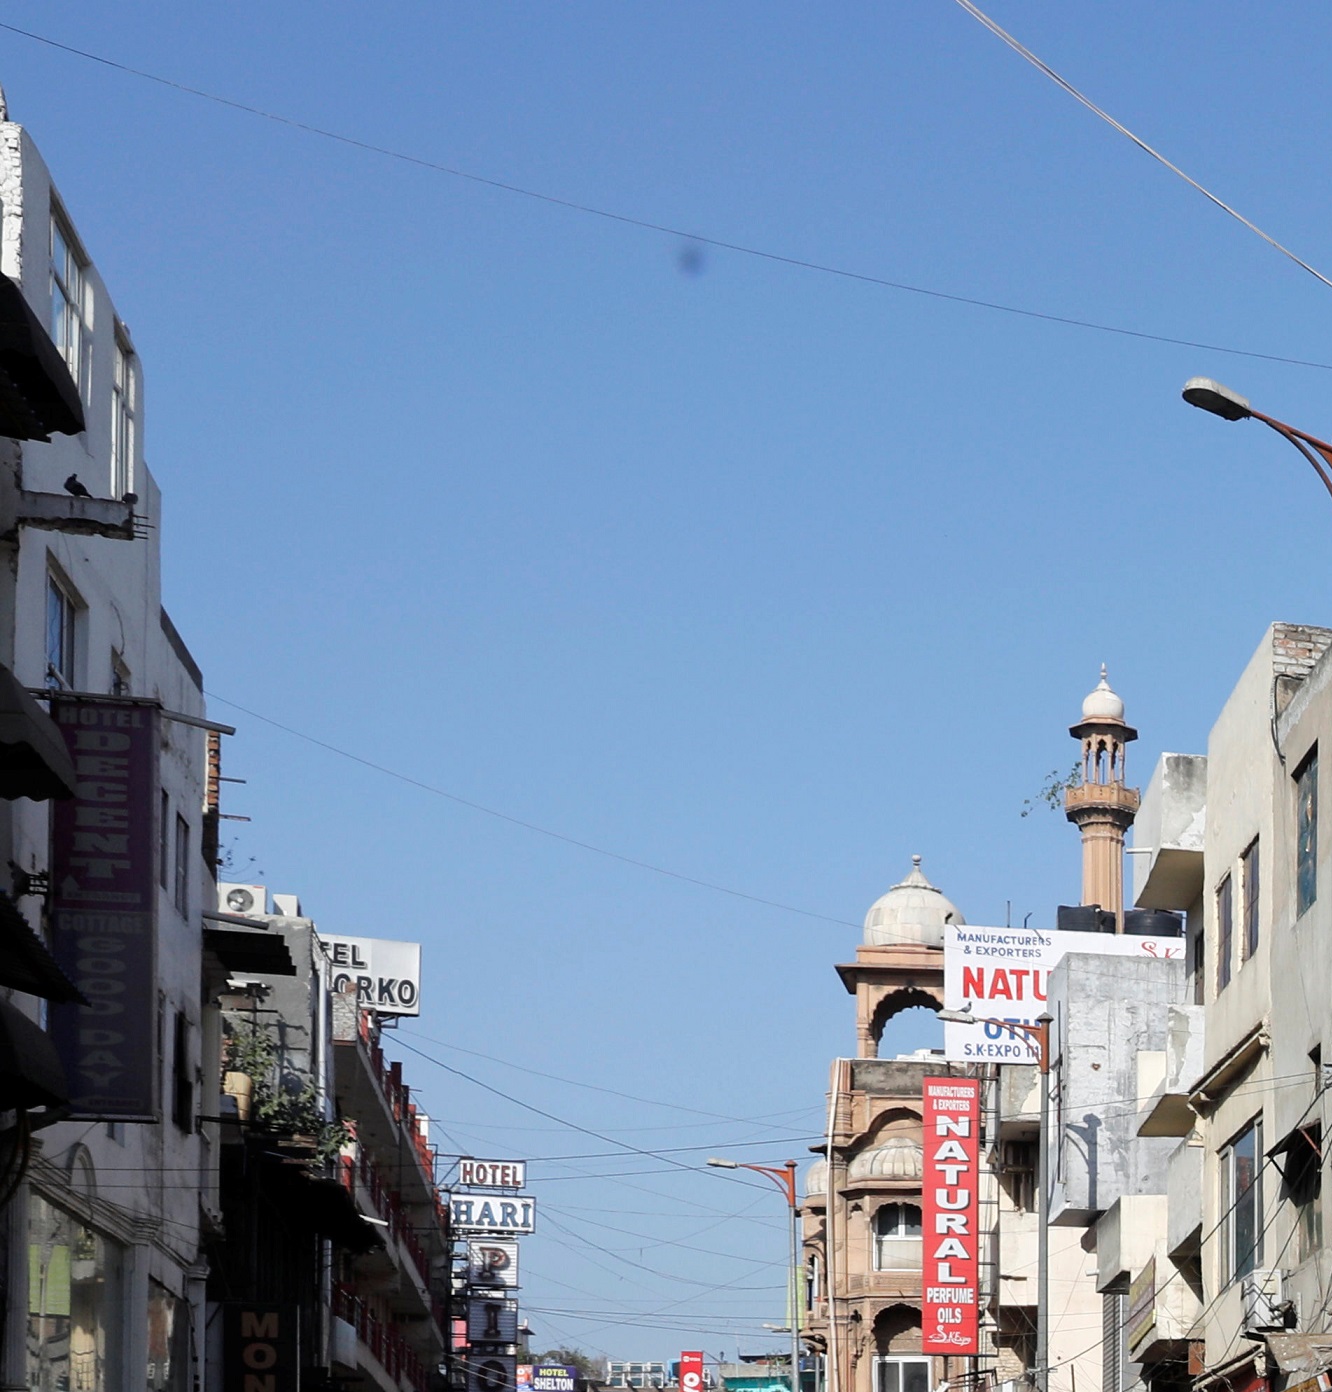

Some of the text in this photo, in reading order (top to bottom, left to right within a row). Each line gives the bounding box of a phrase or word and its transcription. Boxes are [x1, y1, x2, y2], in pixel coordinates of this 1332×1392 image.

[58, 706, 144, 728] HOTEL
[957, 933, 1052, 946] MANUFACTURERS
[964, 945, 1042, 957] & EXPORTERS
[963, 966, 1053, 1001] NATU
[77, 1029, 126, 1087] DAY
[928, 1085, 975, 1098] MANUFACTURERS
[933, 1099, 970, 1112] & EXPORTERS
[462, 1162, 522, 1186] HOTEL
[933, 1115, 971, 1284] NATURAL
[452, 1200, 532, 1228] HARI
[927, 1287, 974, 1304] PERFUME
[937, 1308, 962, 1323] OILS
[539, 1368, 569, 1377] HOTEL
[534, 1377, 574, 1391] SHELTON
